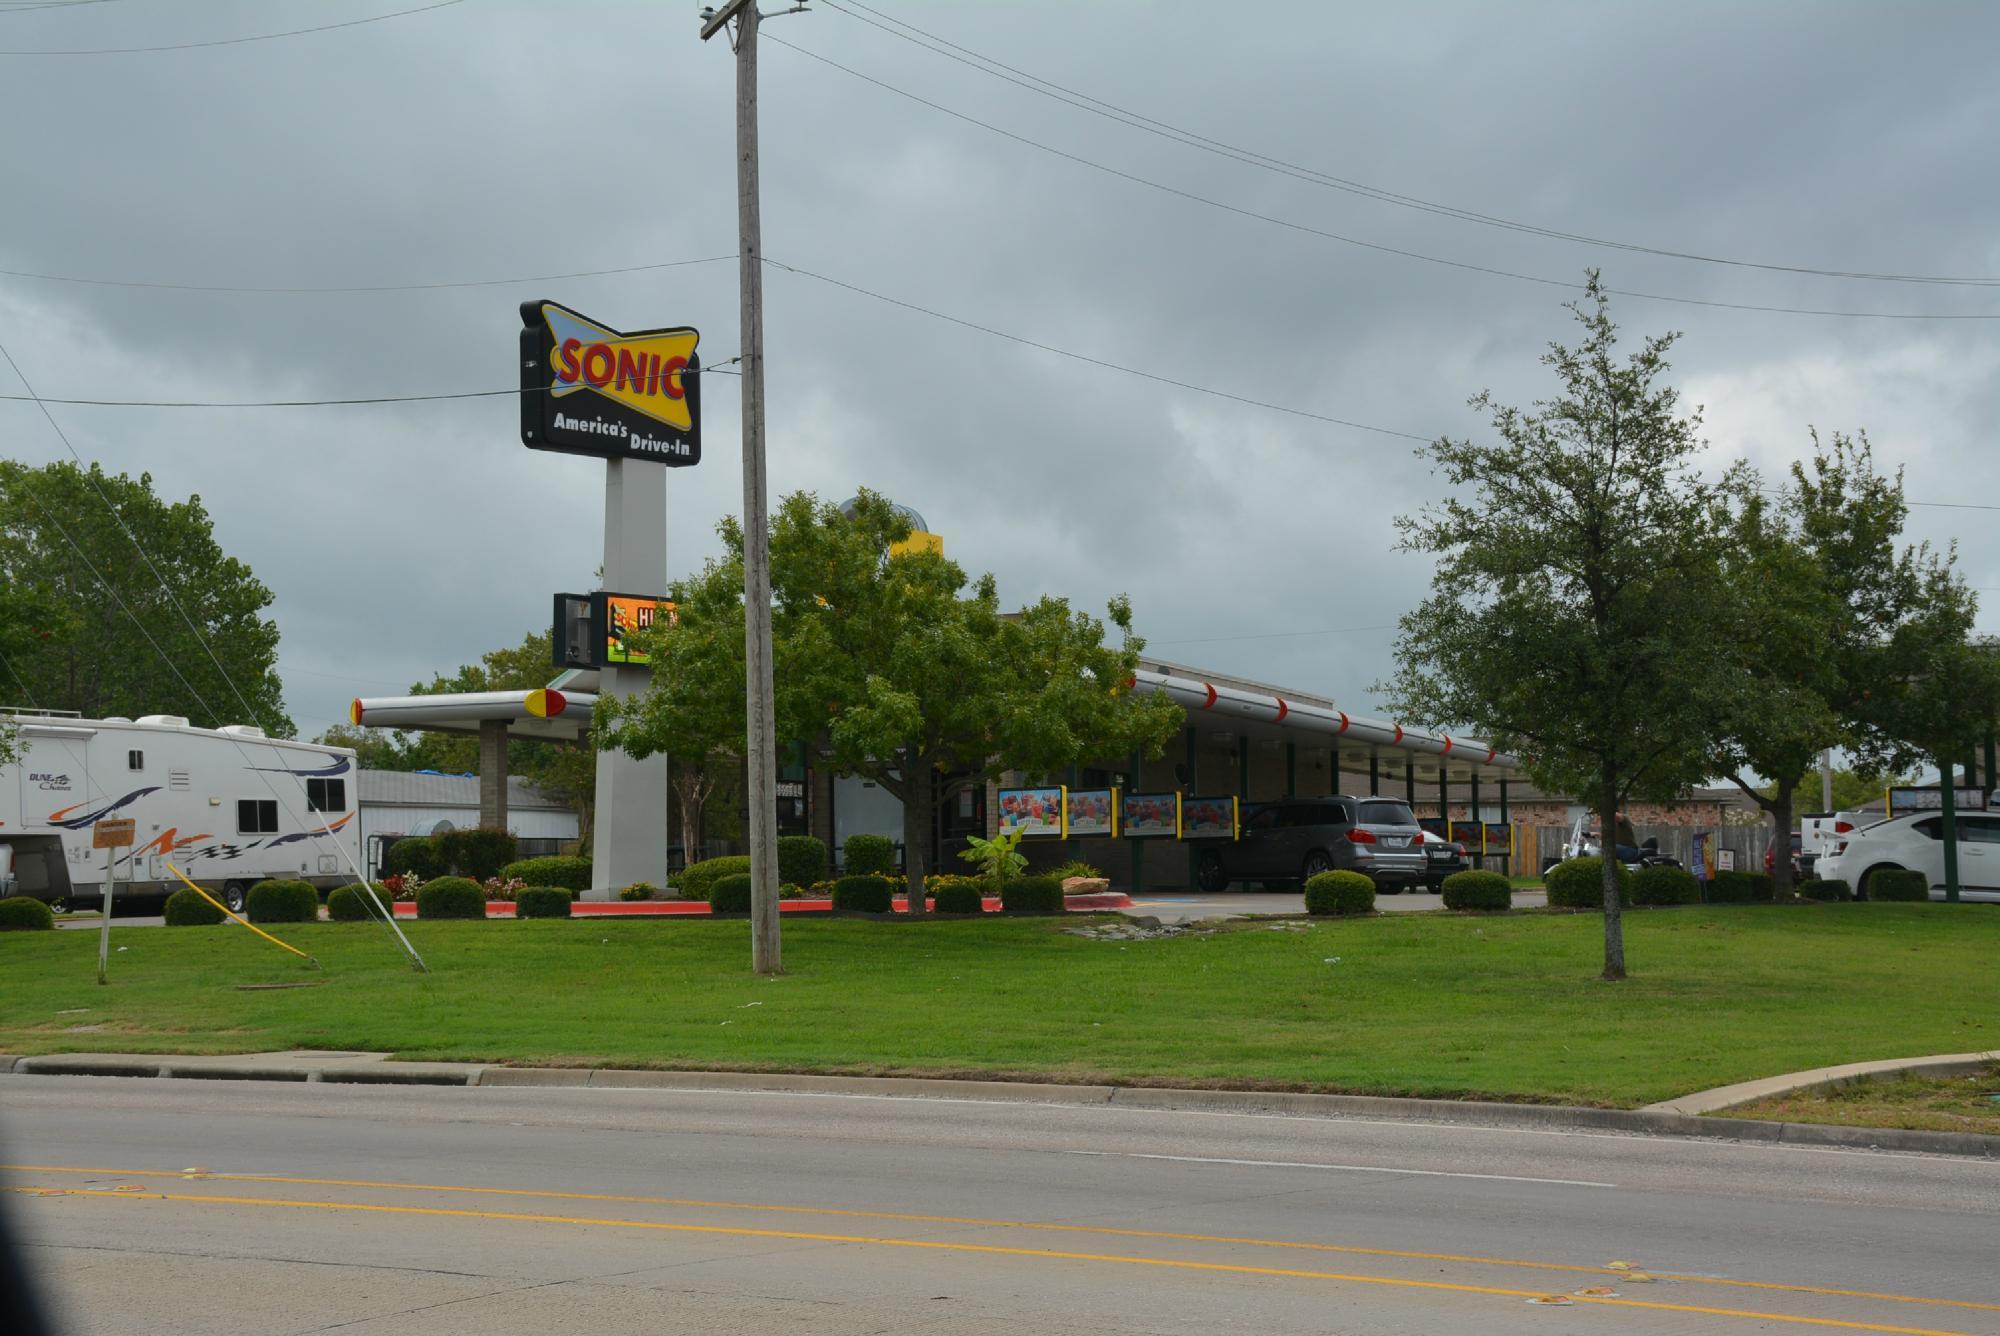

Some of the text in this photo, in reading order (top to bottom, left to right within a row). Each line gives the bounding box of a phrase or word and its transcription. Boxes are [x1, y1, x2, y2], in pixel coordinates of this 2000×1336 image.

[556, 337, 689, 400] SONIC
[554, 412, 691, 456] America's Drive-In
